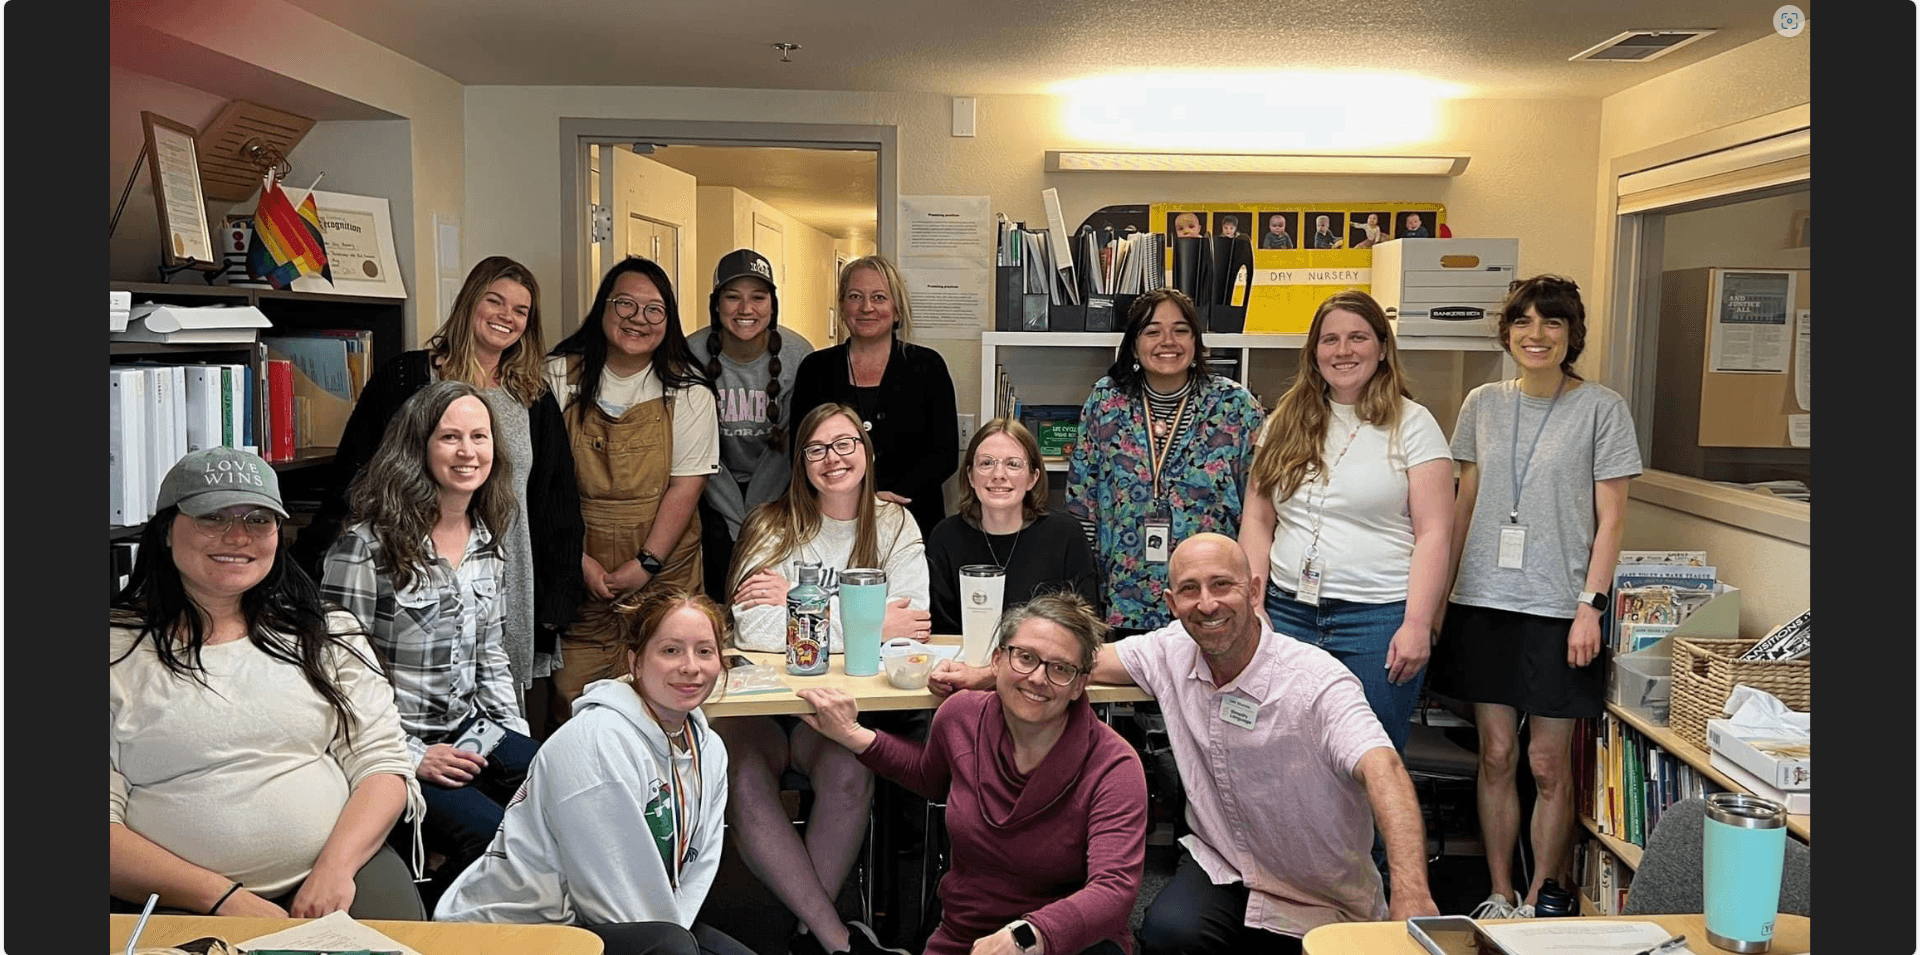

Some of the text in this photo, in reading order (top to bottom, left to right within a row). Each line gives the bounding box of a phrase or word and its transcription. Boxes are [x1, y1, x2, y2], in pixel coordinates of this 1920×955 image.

[323, 220, 362, 233] ecognition
[1270, 272, 1293, 281] DAY
[1308, 271, 1359, 281] NURSERY
[205, 460, 259, 474] LOVE
[203, 472, 263, 487] WINS
